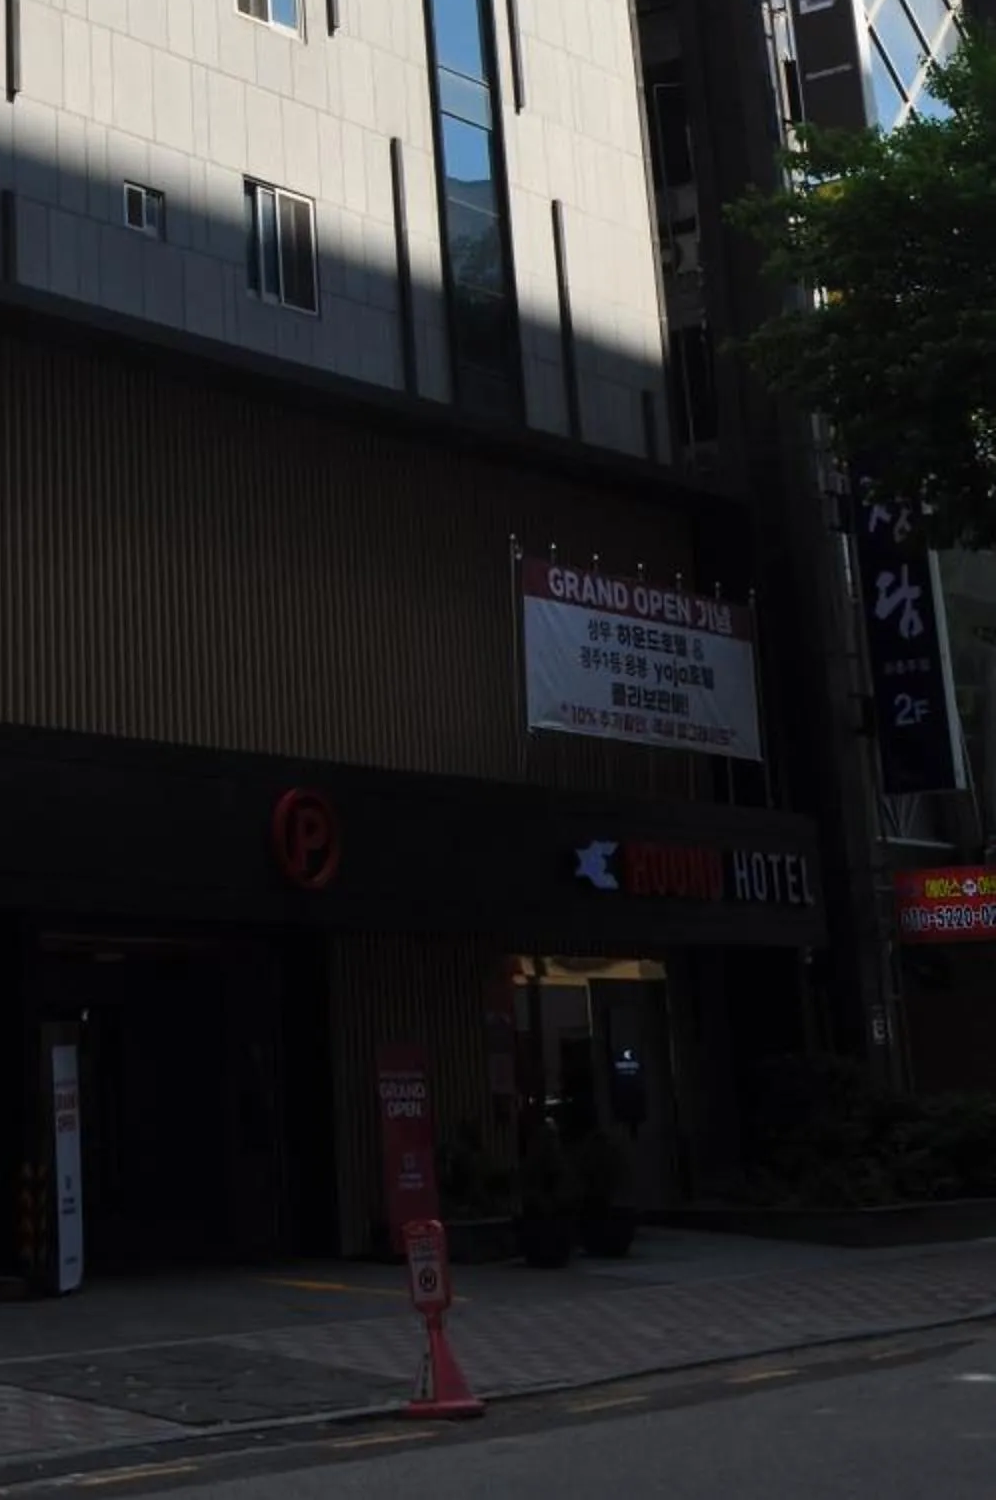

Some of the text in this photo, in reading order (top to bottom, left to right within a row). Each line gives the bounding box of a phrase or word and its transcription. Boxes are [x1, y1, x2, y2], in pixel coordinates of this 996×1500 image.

[547, 567, 629, 612] GRAND
[633, 587, 692, 624] OPEN
[892, 692, 932, 728] 2F
[732, 848, 816, 908] HOTEL
